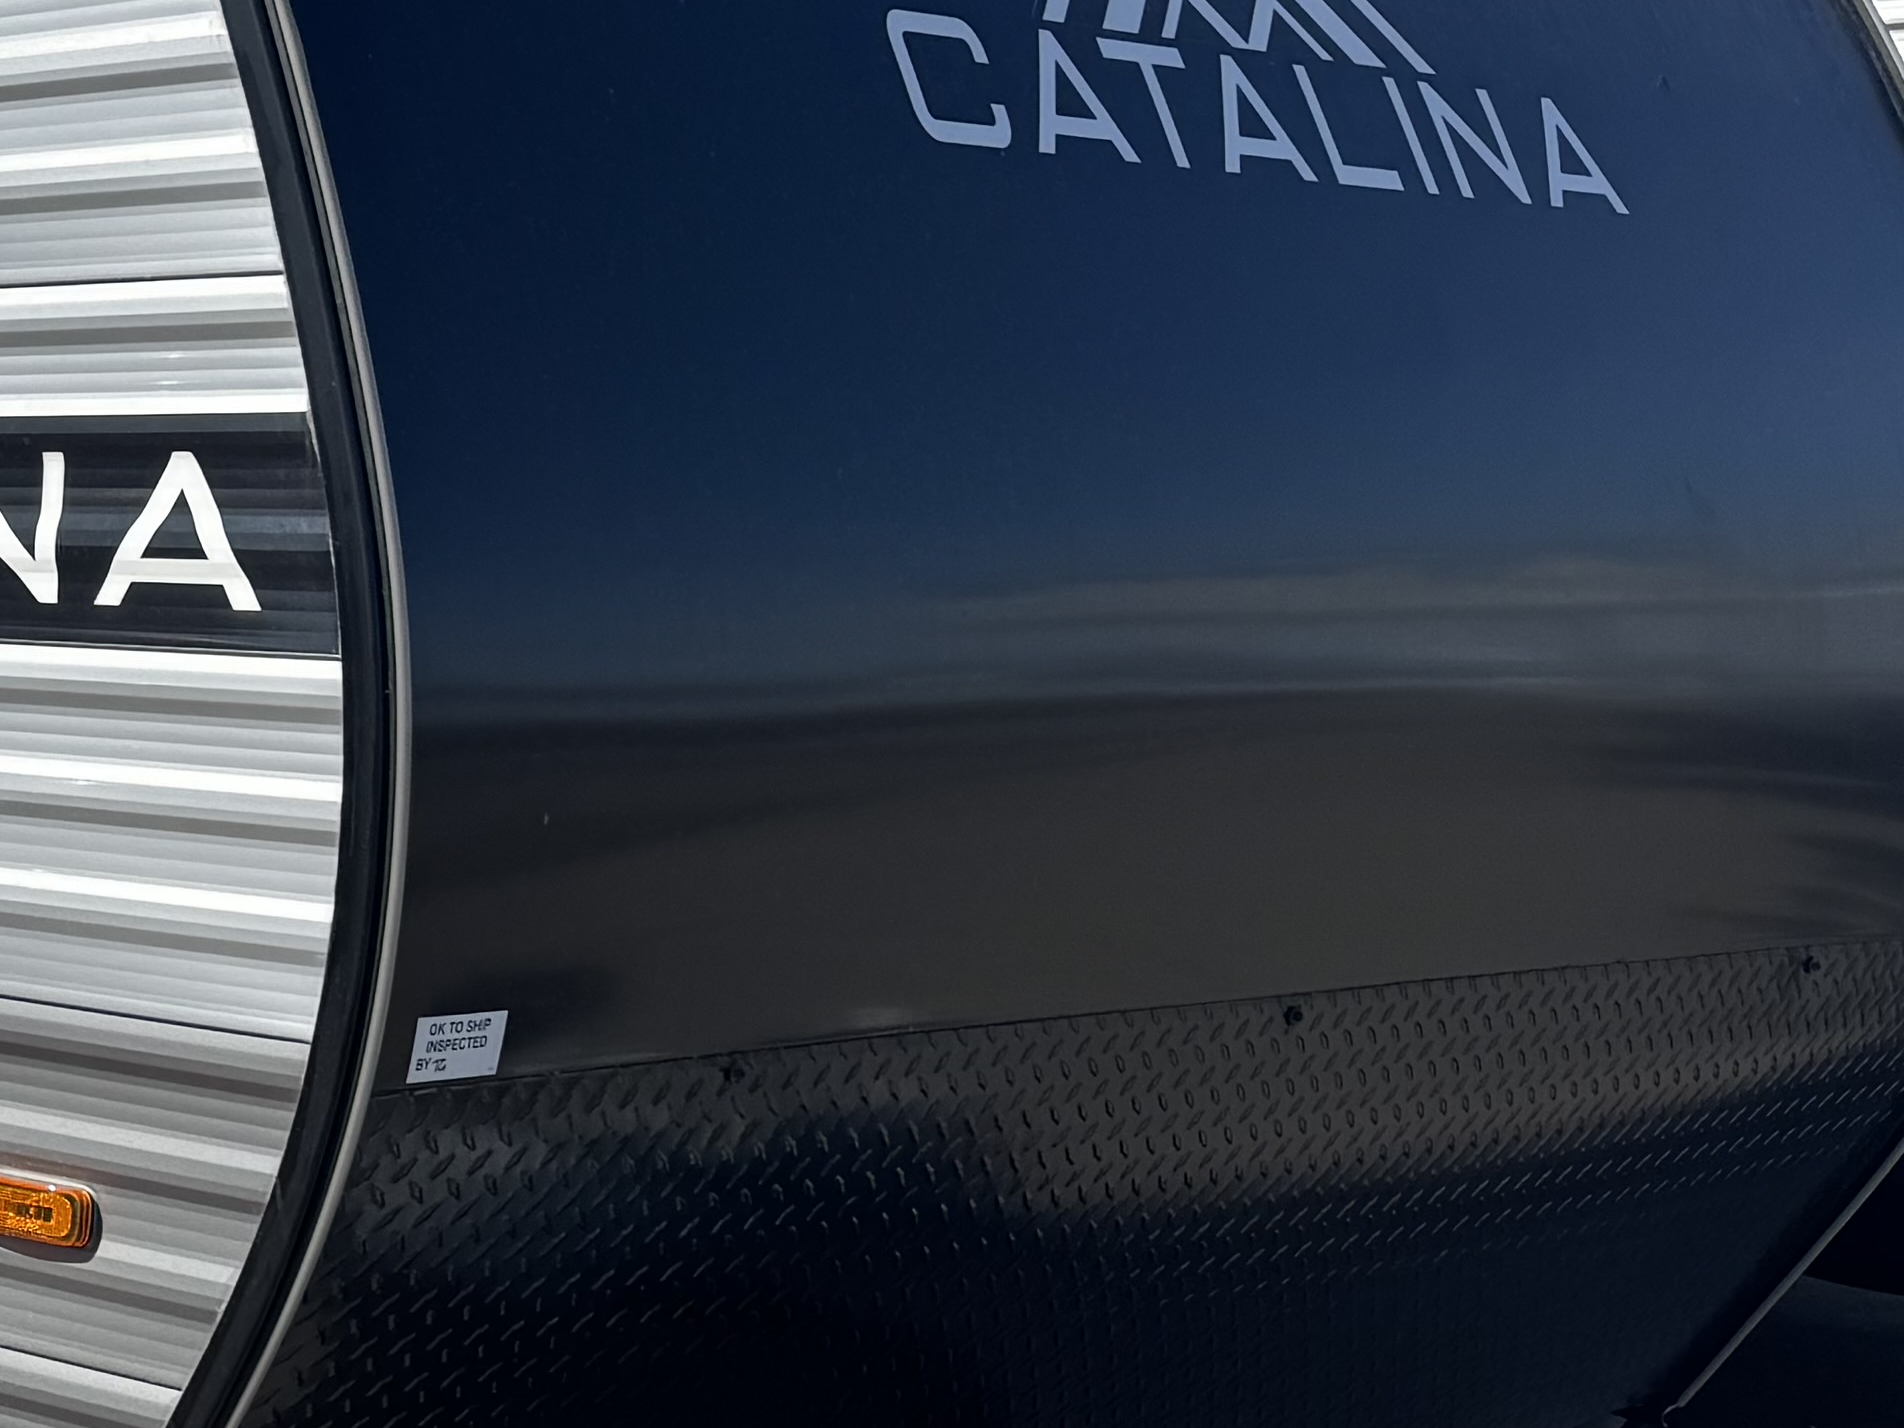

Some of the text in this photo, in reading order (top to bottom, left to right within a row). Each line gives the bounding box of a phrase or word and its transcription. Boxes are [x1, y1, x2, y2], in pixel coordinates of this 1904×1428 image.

[885, 9, 1630, 215] CATALINA
[429, 1017, 492, 1036] OK TO SHIP
[426, 1035, 487, 1053] INSPECTED
[415, 1057, 432, 1072] BY
